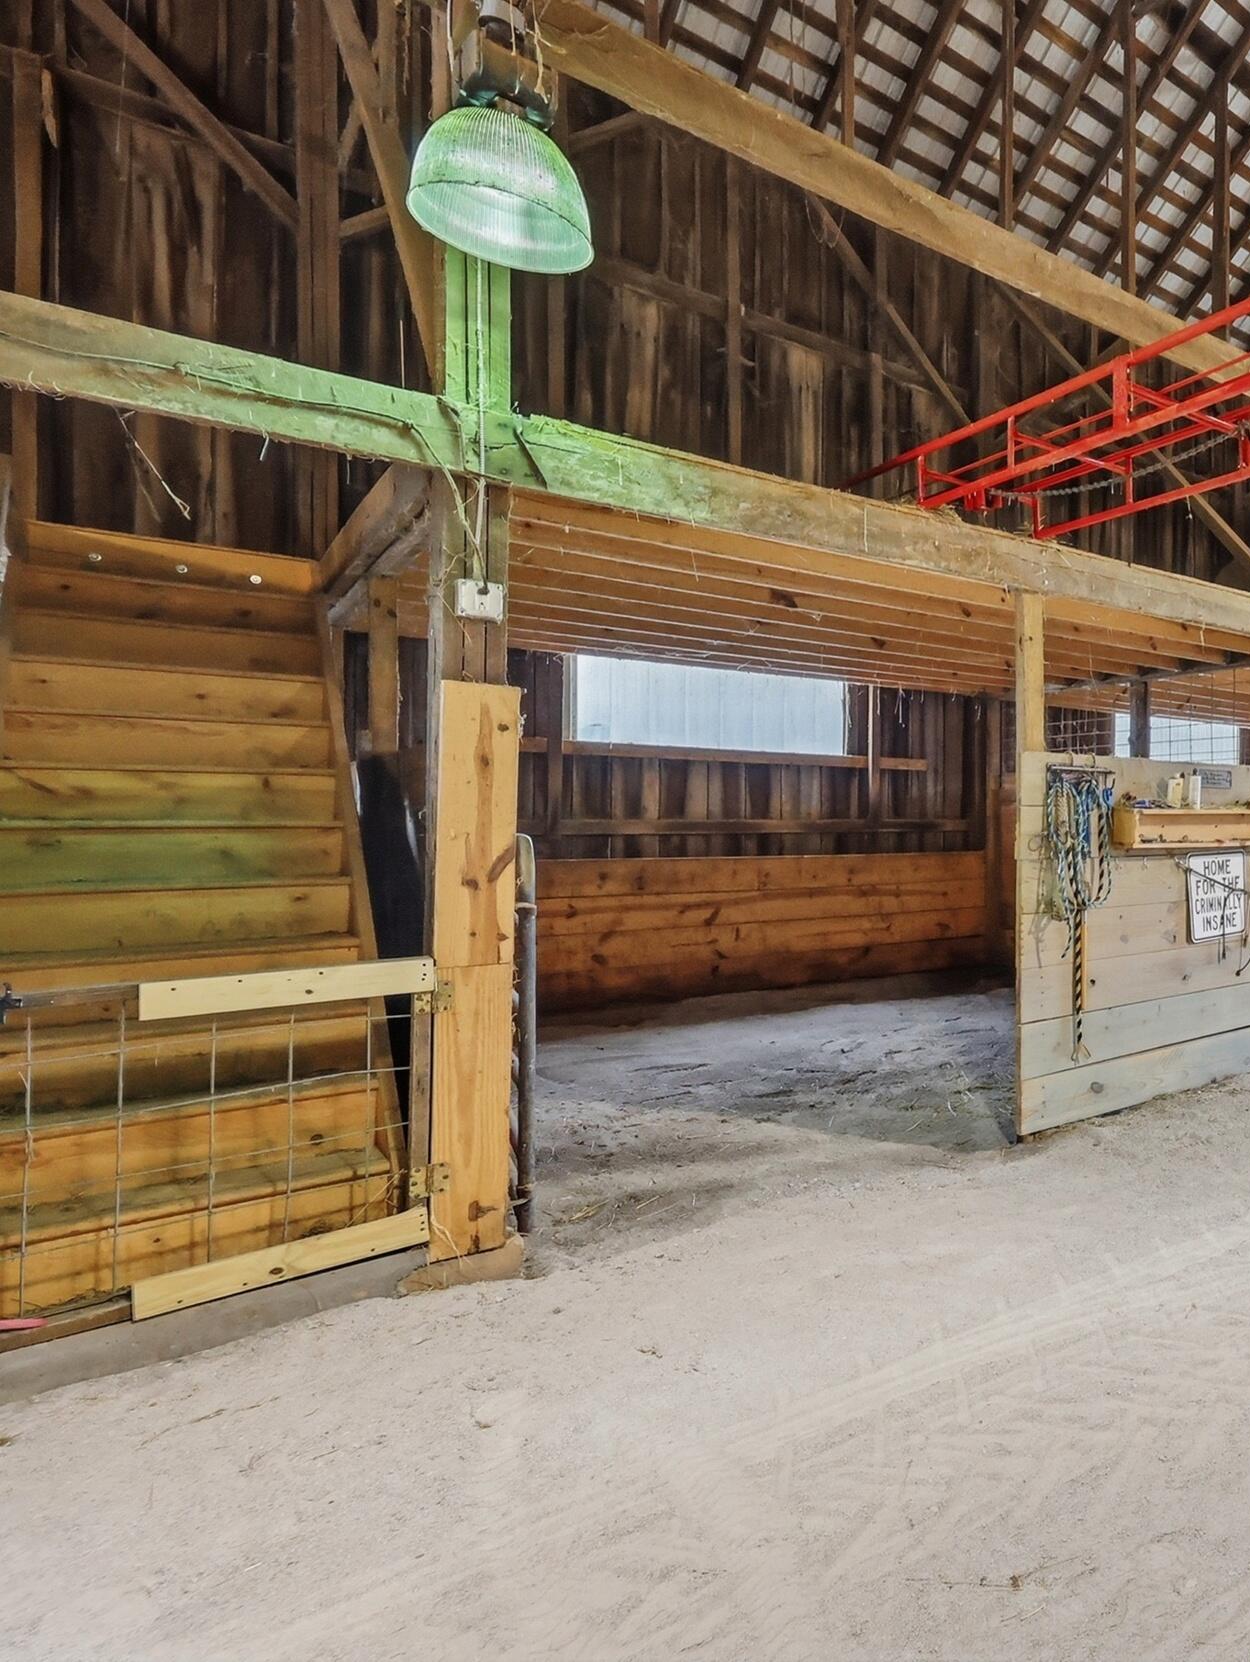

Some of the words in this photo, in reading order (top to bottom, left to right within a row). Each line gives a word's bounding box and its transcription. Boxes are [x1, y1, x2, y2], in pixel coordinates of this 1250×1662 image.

[1203, 859, 1231, 876] HOME
[1195, 878, 1216, 896] FOR
[1222, 876, 1240, 892] THE
[1202, 912, 1237, 932] INSANE
